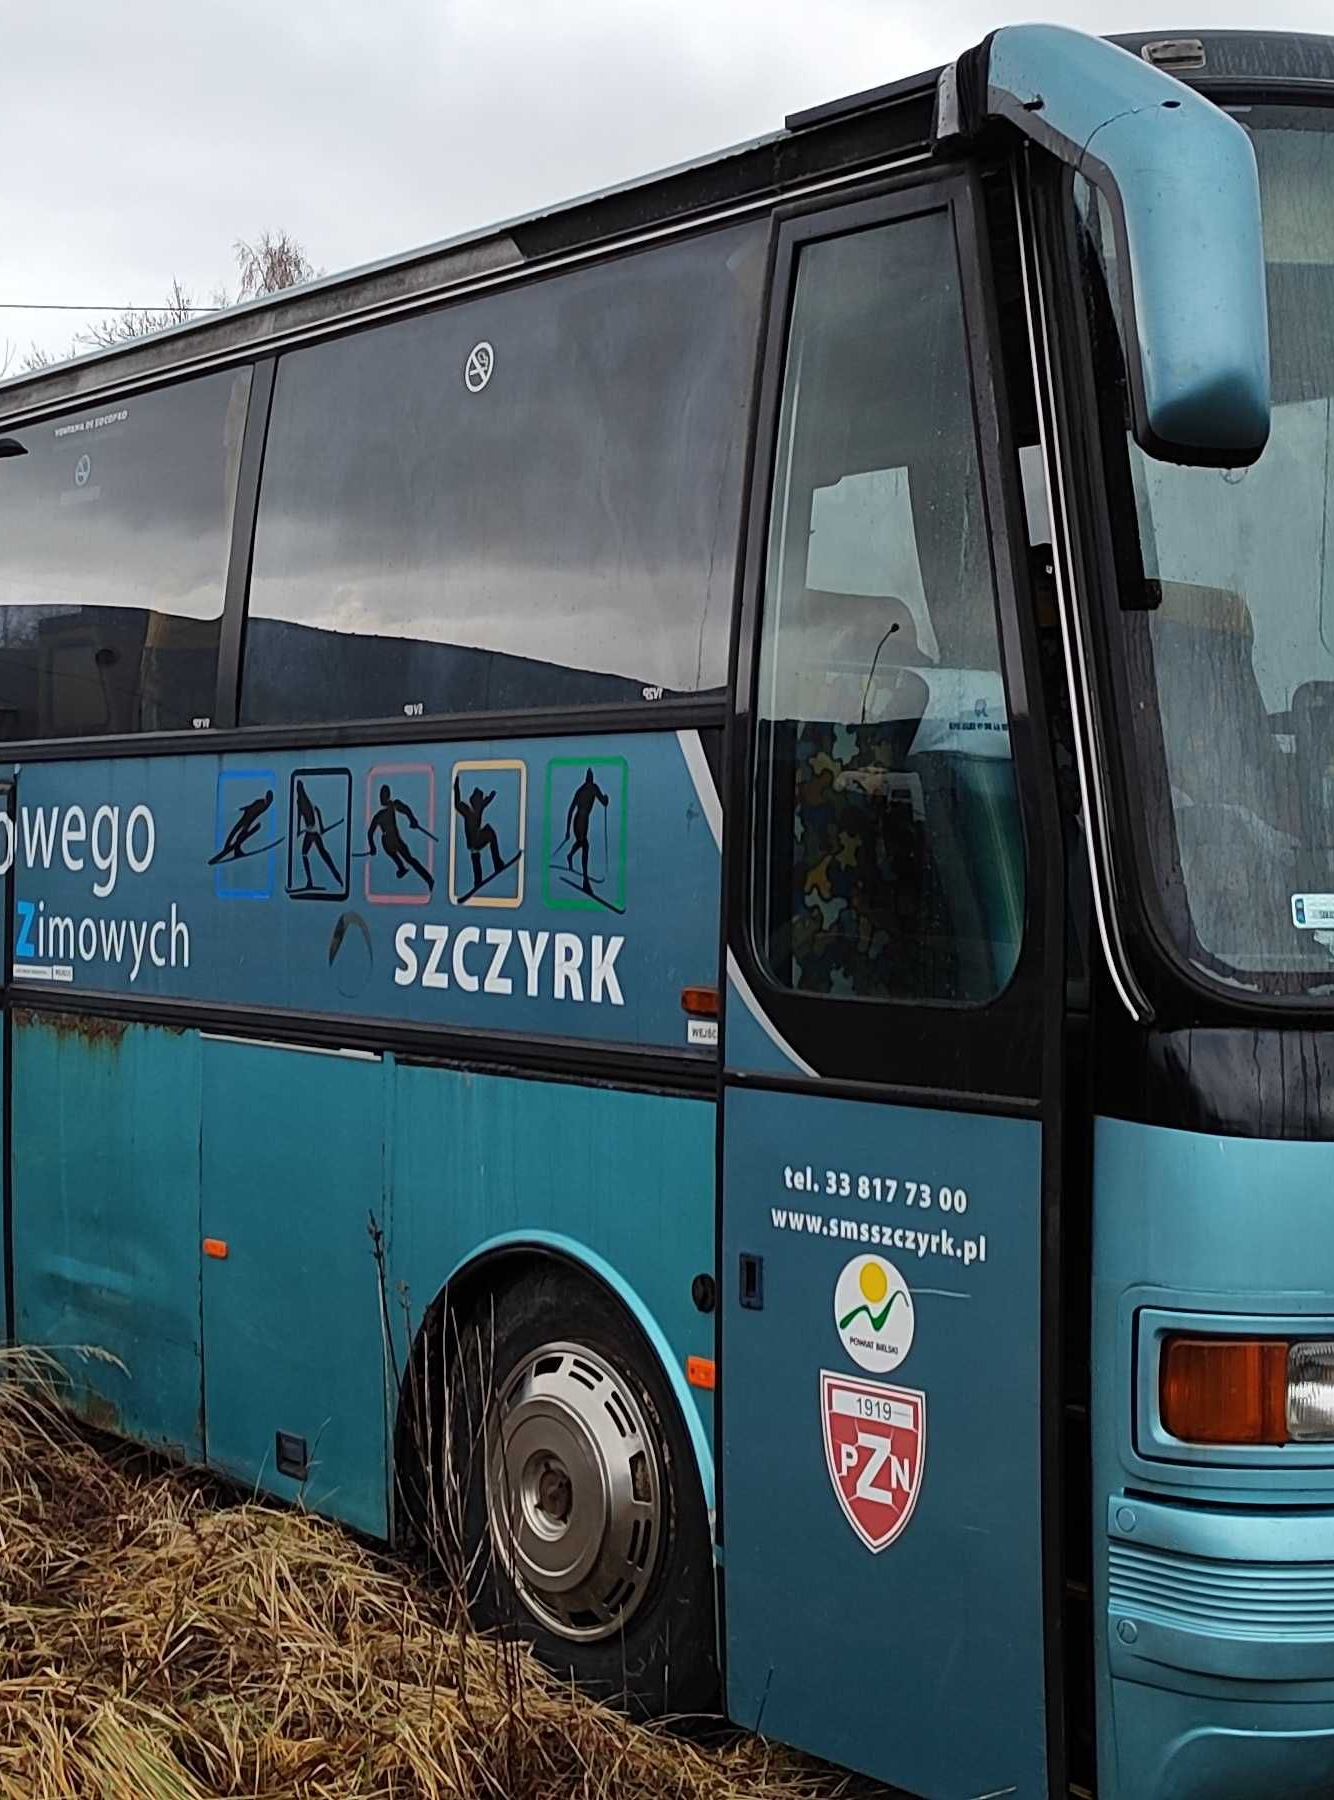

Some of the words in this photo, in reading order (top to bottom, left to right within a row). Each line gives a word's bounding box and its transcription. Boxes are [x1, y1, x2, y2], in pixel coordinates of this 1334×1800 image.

[17, 900, 190, 983] Zimowych
[394, 923, 626, 1006] SZCZYRK
[783, 1165, 819, 1192] tel.
[825, 1170, 851, 1196] 33
[857, 1175, 898, 1203] 817
[904, 1181, 931, 1208] 73
[938, 1186, 967, 1214] 00
[771, 1207, 986, 1265] www.smsszczyrk.pl
[856, 1397, 892, 1421] 1919
